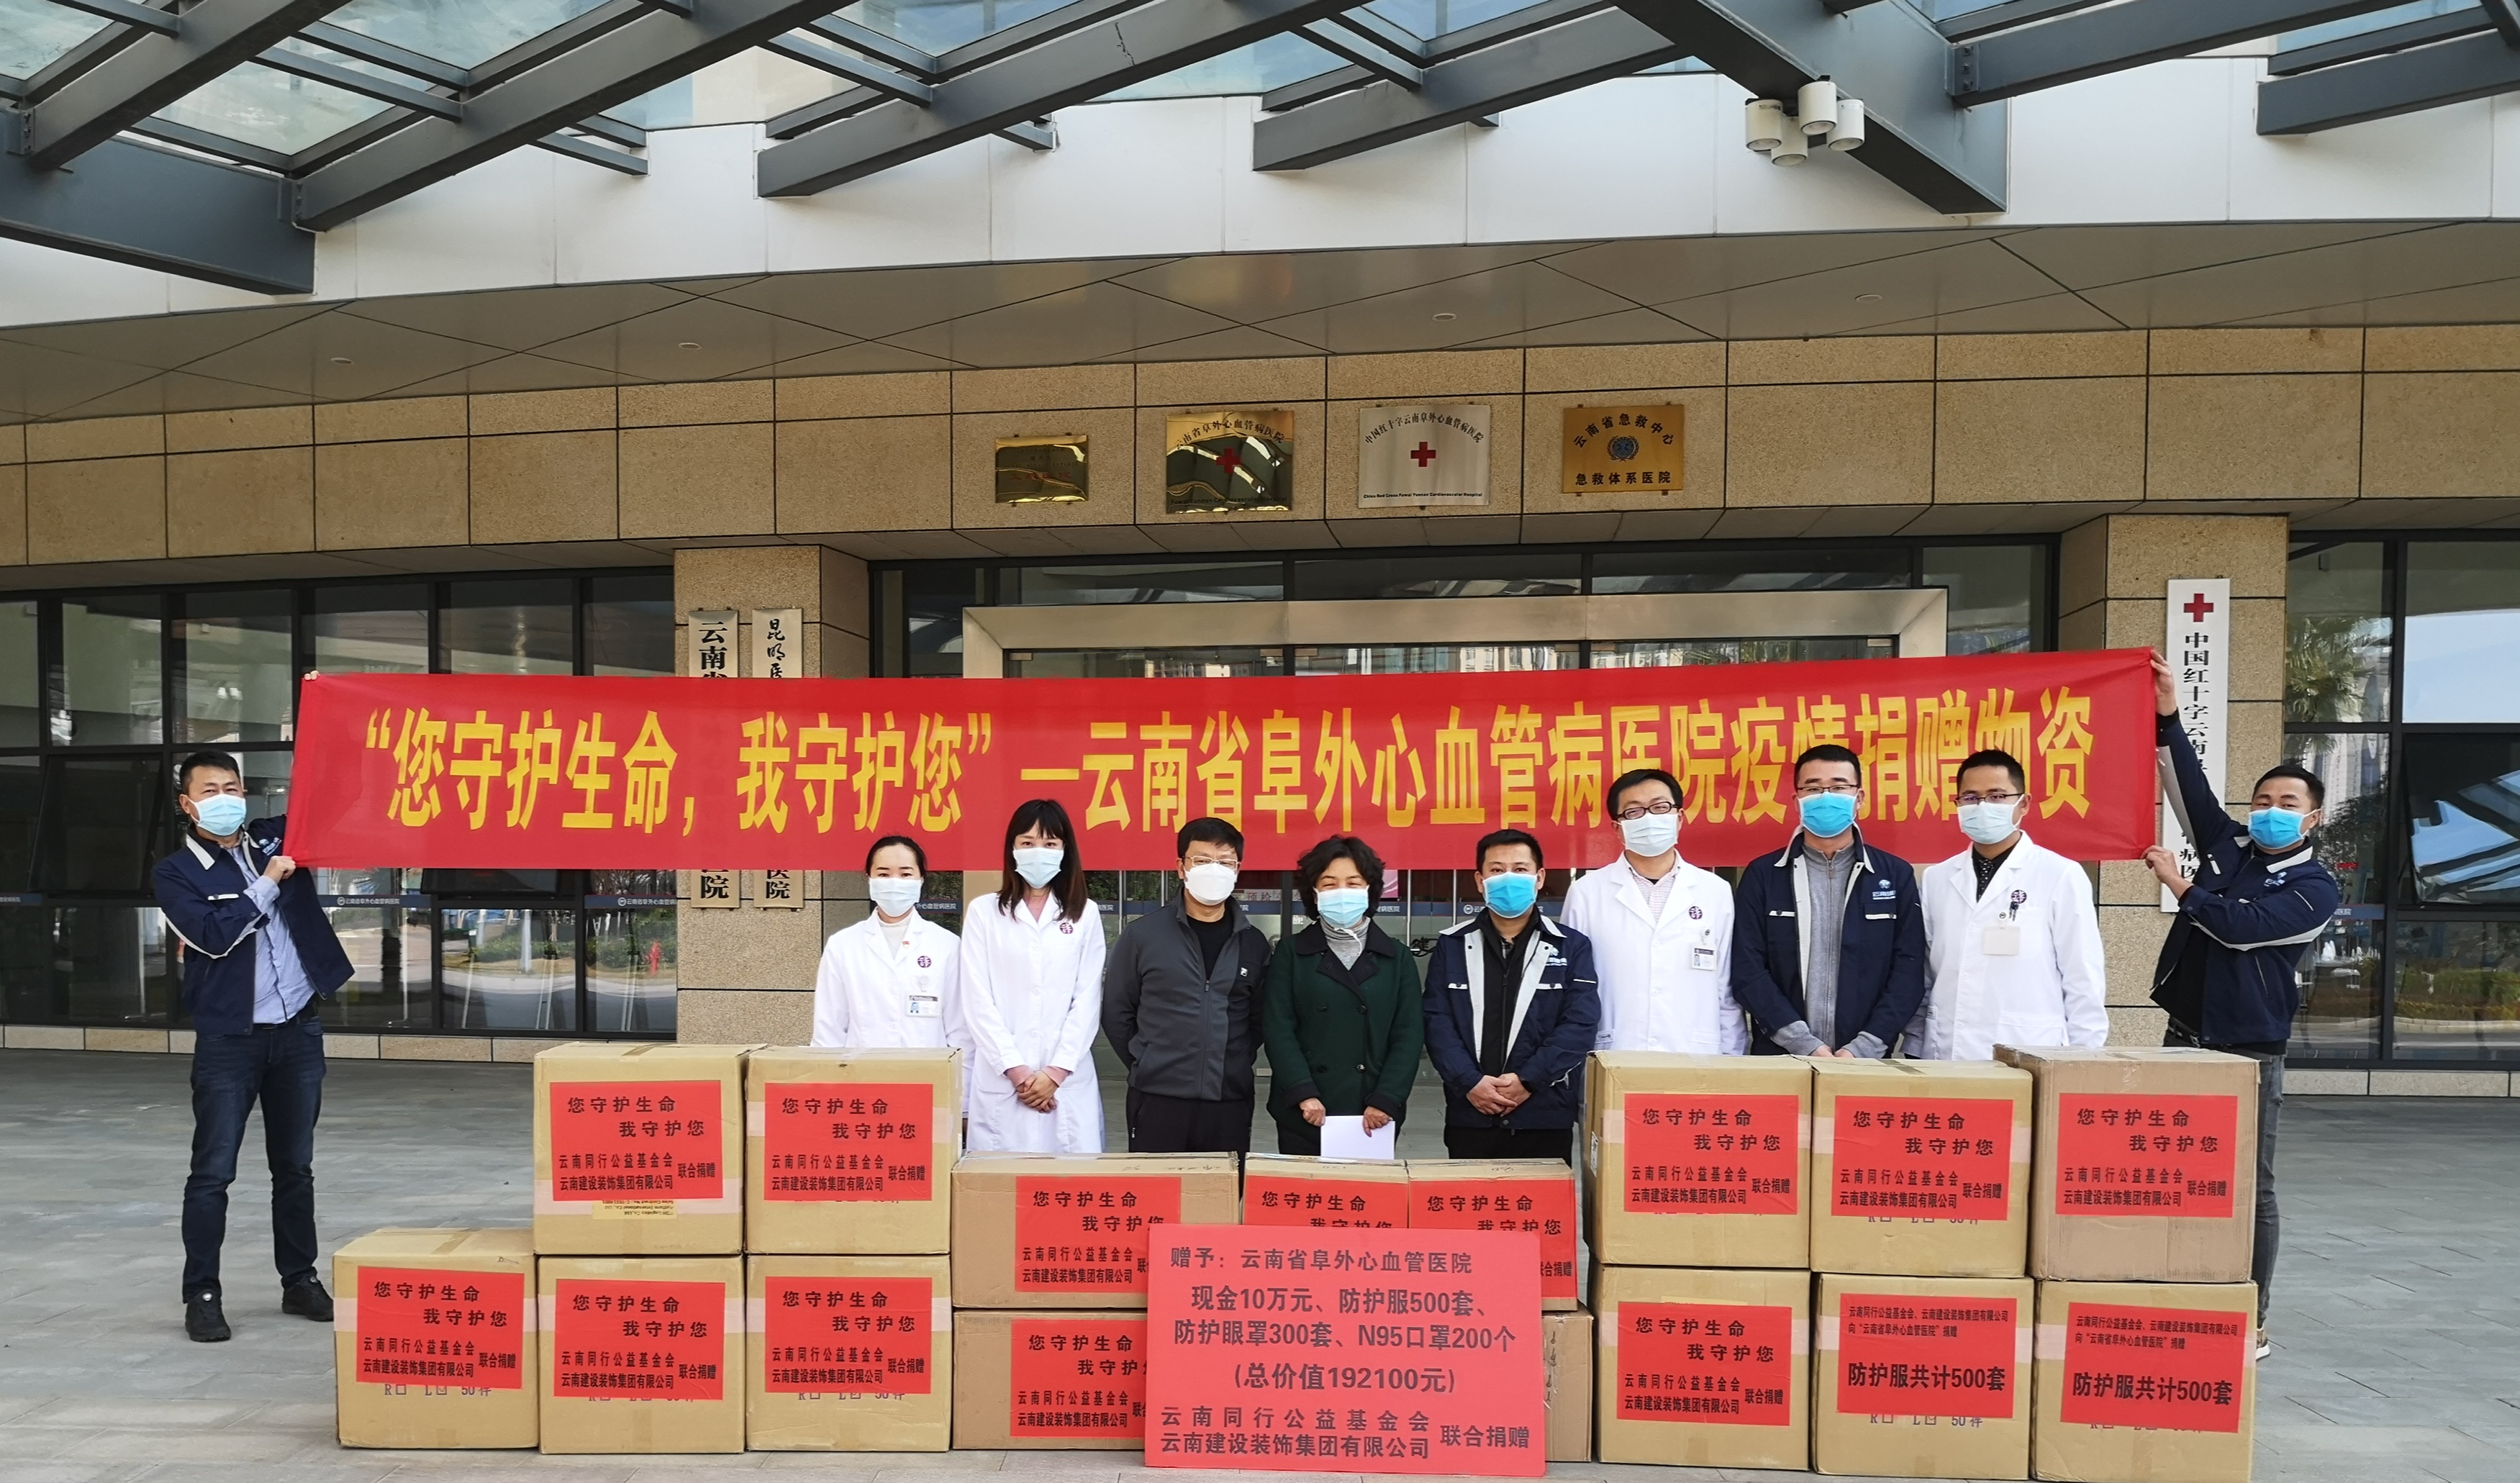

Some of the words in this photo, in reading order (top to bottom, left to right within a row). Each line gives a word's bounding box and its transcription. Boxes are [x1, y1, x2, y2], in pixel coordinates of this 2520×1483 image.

[1176, 419, 1285, 450] 云南省阜外心血管病医院
[1365, 412, 1484, 444] 中国红十字云南阜外心血管病医院
[1574, 413, 1674, 448] 云南省急救中心
[1575, 471, 1671, 486] 急救体系医院
[701, 869, 730, 899] 院
[568, 1096, 676, 1114] 您守护生命
[783, 1098, 888, 1115] 您守护生命
[1643, 1109, 1752, 1127] 您守护生命
[1854, 1111, 1965, 1130] 您守护生命
[2077, 1109, 2190, 1128] 您守护生命
[620, 1120, 704, 1138] 我守护您
[833, 1123, 915, 1140] 我守护您
[1695, 1134, 1780, 1151] 我守护您
[1905, 1138, 1993, 1156] 我守护您
[2129, 1135, 2218, 1153] 我守护您
[559, 1153, 673, 1169] 云南同行公益基金会
[772, 1154, 884, 1170] 云南同行公益基金会
[679, 1163, 716, 1179] 联合捐赠
[889, 1166, 925, 1181] 联合捐赠
[1632, 1166, 1747, 1182] 云南同行公益基金会
[1841, 1169, 1958, 1187] 云南同行公益基金会
[2065, 1168, 2183, 1184] 云南同行公益基金会
[560, 1175, 673, 1191] 云南建设装饰集团有限公司
[772, 1176, 883, 1192] 云南建设装饰集团有限公司
[1752, 1179, 1790, 1194] 联合捐赠
[1963, 1183, 2003, 1199] 联合捐赠
[2188, 1181, 2227, 1197] 联合捐赠
[1033, 1192, 1137, 1208] 您守护生命
[1262, 1192, 1366, 1212] 您守护生命
[1428, 1195, 1533, 1212] 您守护生命
[1632, 1188, 1746, 1205] 云南建设装饰集团有限公司
[1840, 1191, 1957, 1210] 云南建设装饰集团有限公司
[2065, 1190, 2181, 1207] 云南建设装饰集团有限公司
[1477, 1220, 1562, 1235] 我守护您
[1023, 1247, 1133, 1262] 云南同行公益基金会
[1023, 1269, 1133, 1284] 云南建设装饰集团有限公司
[374, 1282, 480, 1302] 您守护生命
[783, 1291, 888, 1308] 您守护生命
[574, 1295, 679, 1314] 您守护生命
[1192, 1285, 1485, 1317] 现金10万元、防护服500套、
[424, 1308, 507, 1328] 我守护您
[833, 1315, 915, 1333] 我守护您
[623, 1320, 707, 1338] 我守护您
[1174, 1319, 1516, 1353] 防护眼罩300套、N95口罩200个
[1636, 1318, 1745, 1338] 您守护生命
[364, 1337, 475, 1356] 云南同行公益基金会
[1029, 1335, 1133, 1352] 您守护生命
[479, 1353, 517, 1369] 联合捐赠
[562, 1351, 674, 1368] 云南同行公益基金会
[773, 1347, 884, 1363] 云南同行公益基金会
[1687, 1343, 1774, 1363] 我守护您
[364, 1359, 474, 1378] 云南建设装饰集团有限公司
[679, 1364, 717, 1379] 联合捐赠
[888, 1359, 925, 1374] 联合捐赠
[562, 1373, 674, 1389] 云南建设装饰集团有限公司
[772, 1369, 883, 1384] 云南建设装饰集团有限公司
[1625, 1374, 1740, 1392] 云南同行公益基金会
[1849, 1362, 2006, 1392] 防护服共计500套
[384, 1384, 392, 1395] R
[425, 1384, 432, 1396] L
[1745, 1389, 1784, 1405] 联合捐赠
[2073, 1372, 2234, 1406] 防护服共计500套
[1018, 1391, 1128, 1407] 云南同行公益基金会
[1625, 1395, 1739, 1415] 云南建设装饰集团有限公司
[1018, 1412, 1128, 1428] 云南建设装饰集团有限公司
[1161, 1405, 1429, 1433] 云南同行公益基金会
[1161, 1430, 1428, 1459] 云南建设装饰集团有限公司
[1441, 1425, 1530, 1448] 联合捐赠
